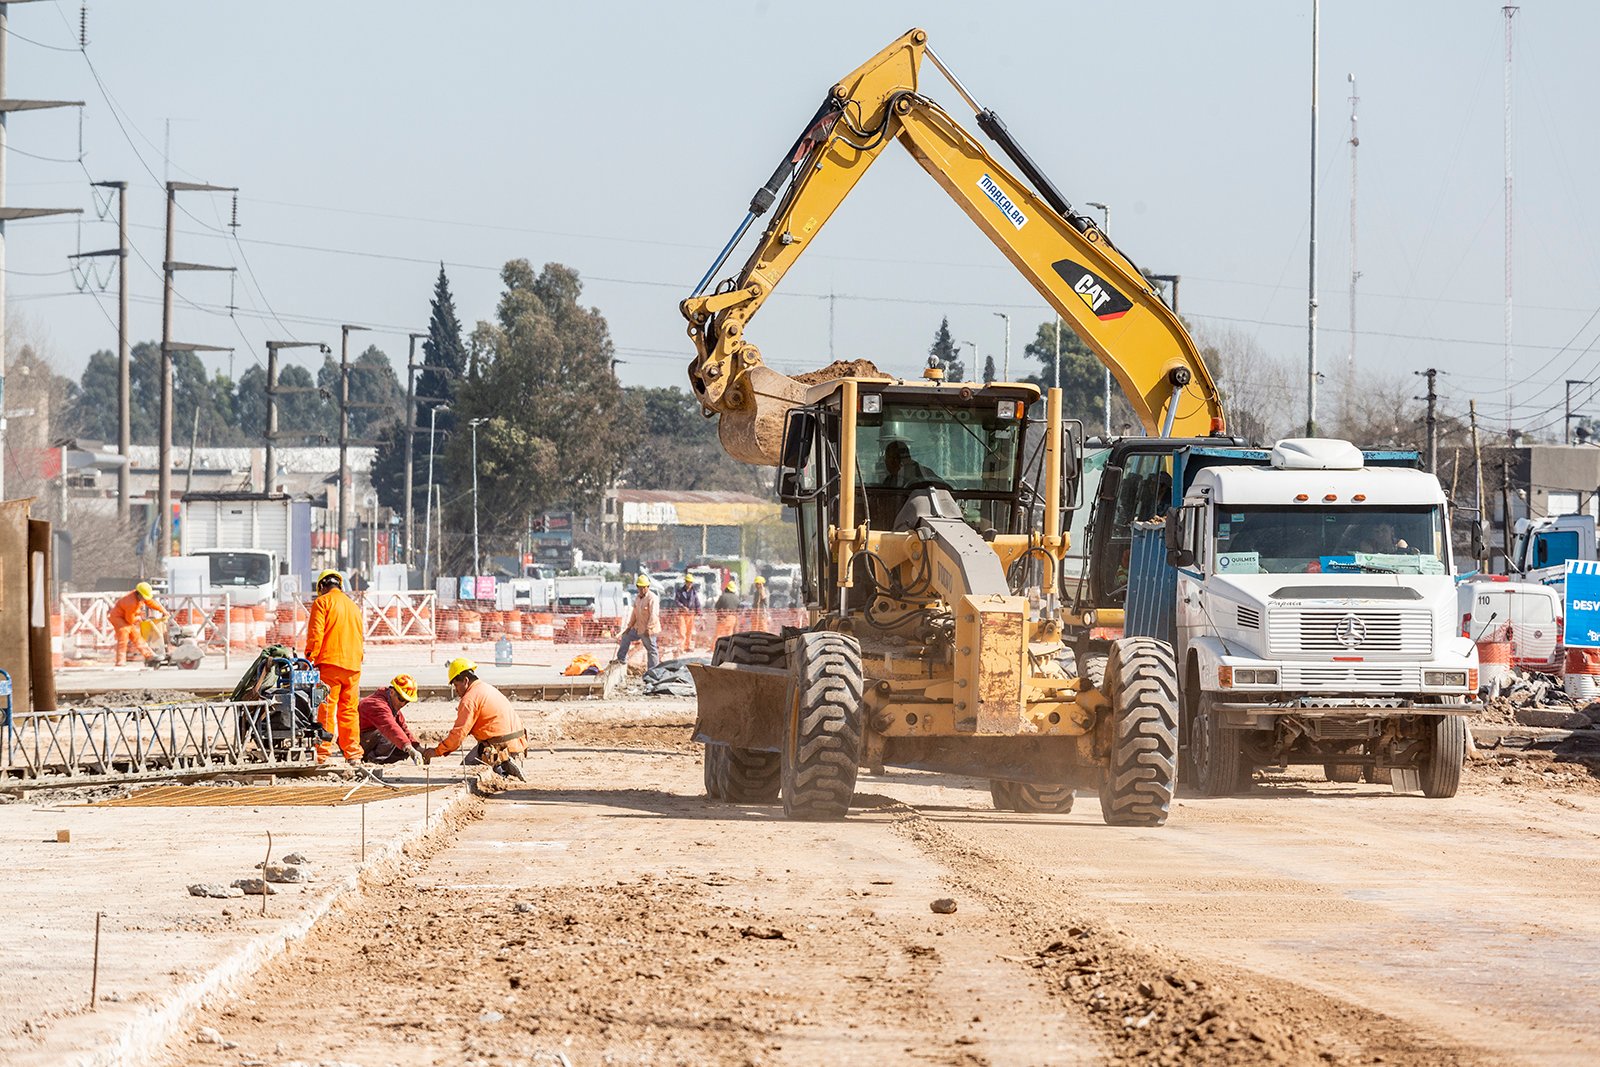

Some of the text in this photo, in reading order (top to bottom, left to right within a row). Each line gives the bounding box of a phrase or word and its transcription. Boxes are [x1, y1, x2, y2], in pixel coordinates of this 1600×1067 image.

[981, 177, 1025, 226] MARCALBA
[1074, 274, 1111, 312] CAT
[899, 408, 971, 421] VOLVO
[1478, 596, 1490, 605] 110
